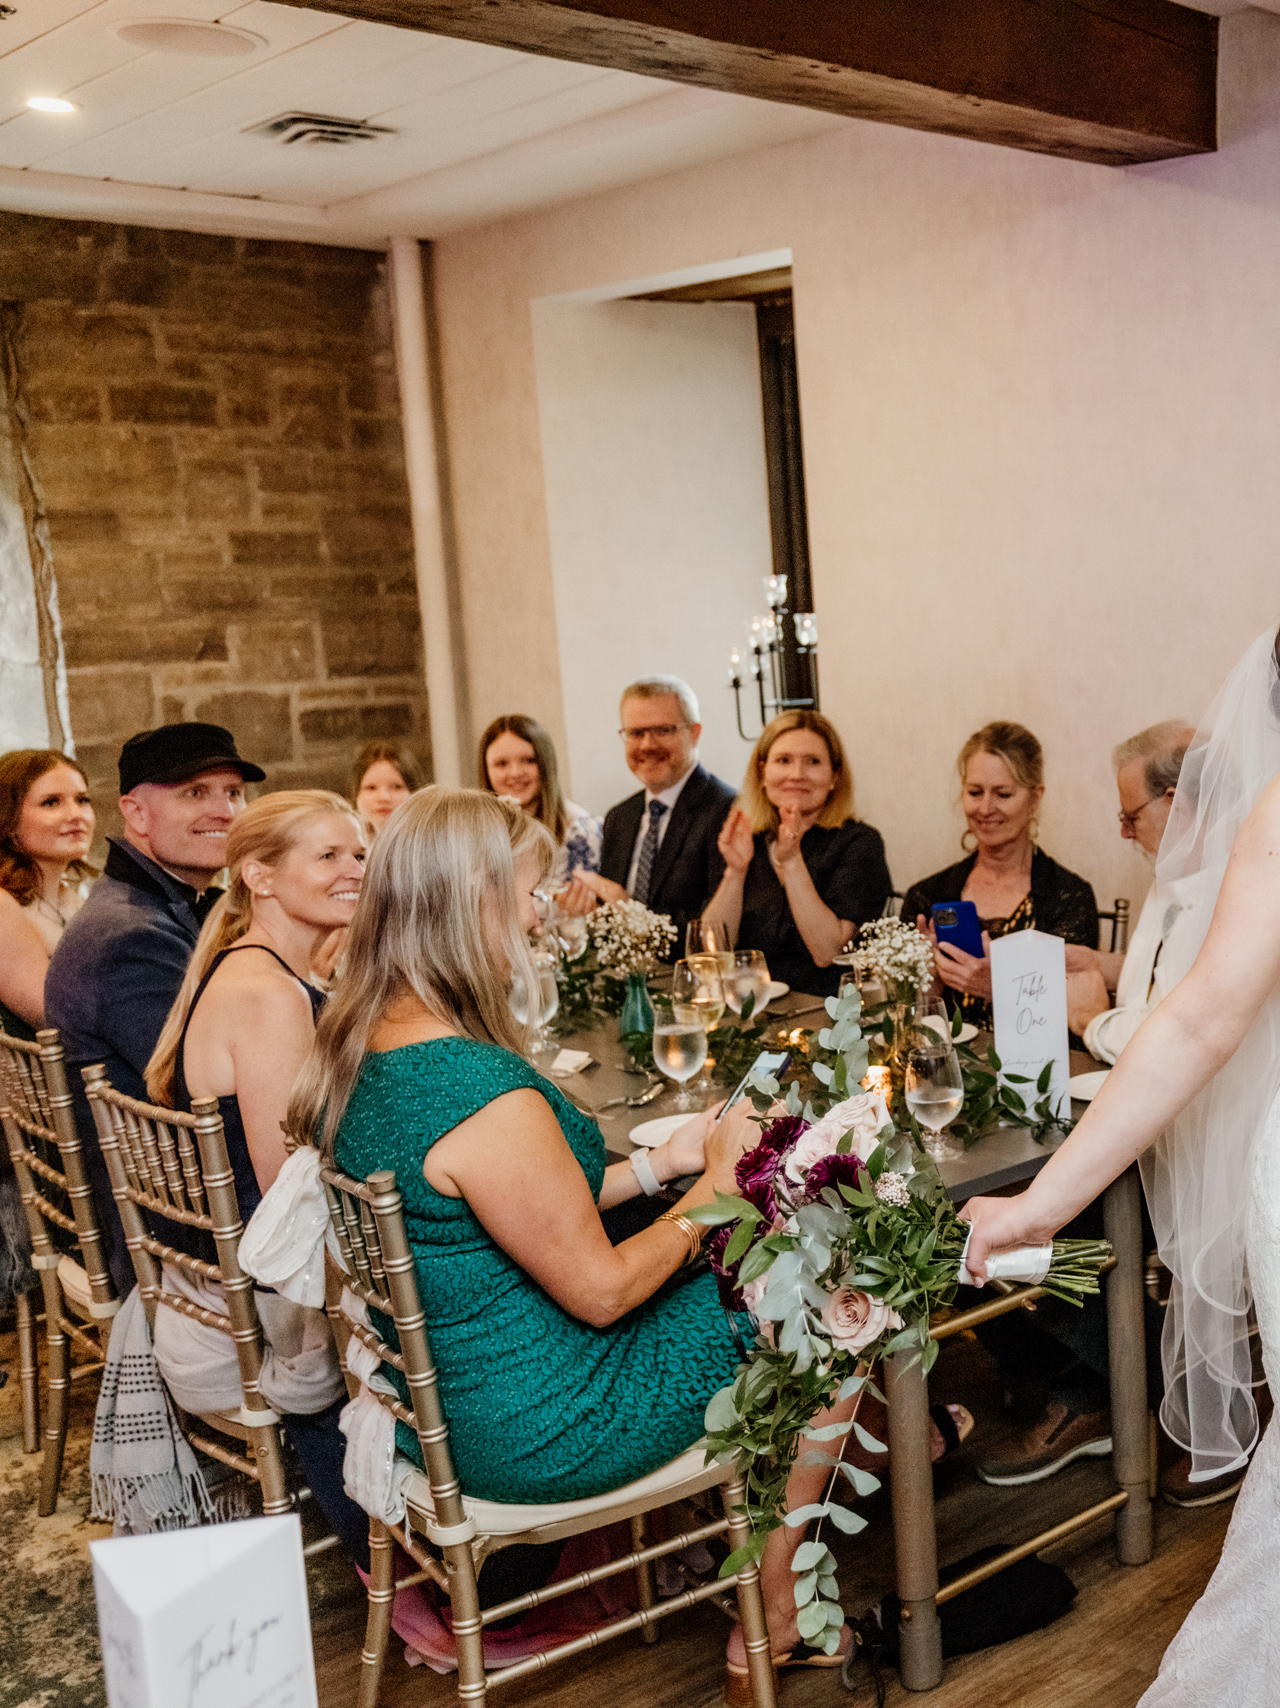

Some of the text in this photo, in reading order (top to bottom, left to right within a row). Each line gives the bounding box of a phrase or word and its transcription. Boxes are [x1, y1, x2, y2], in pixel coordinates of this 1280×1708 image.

[1012, 971, 1048, 1006] Table
[1016, 1007, 1047, 1035] One
[247, 1612, 283, 1675] you
